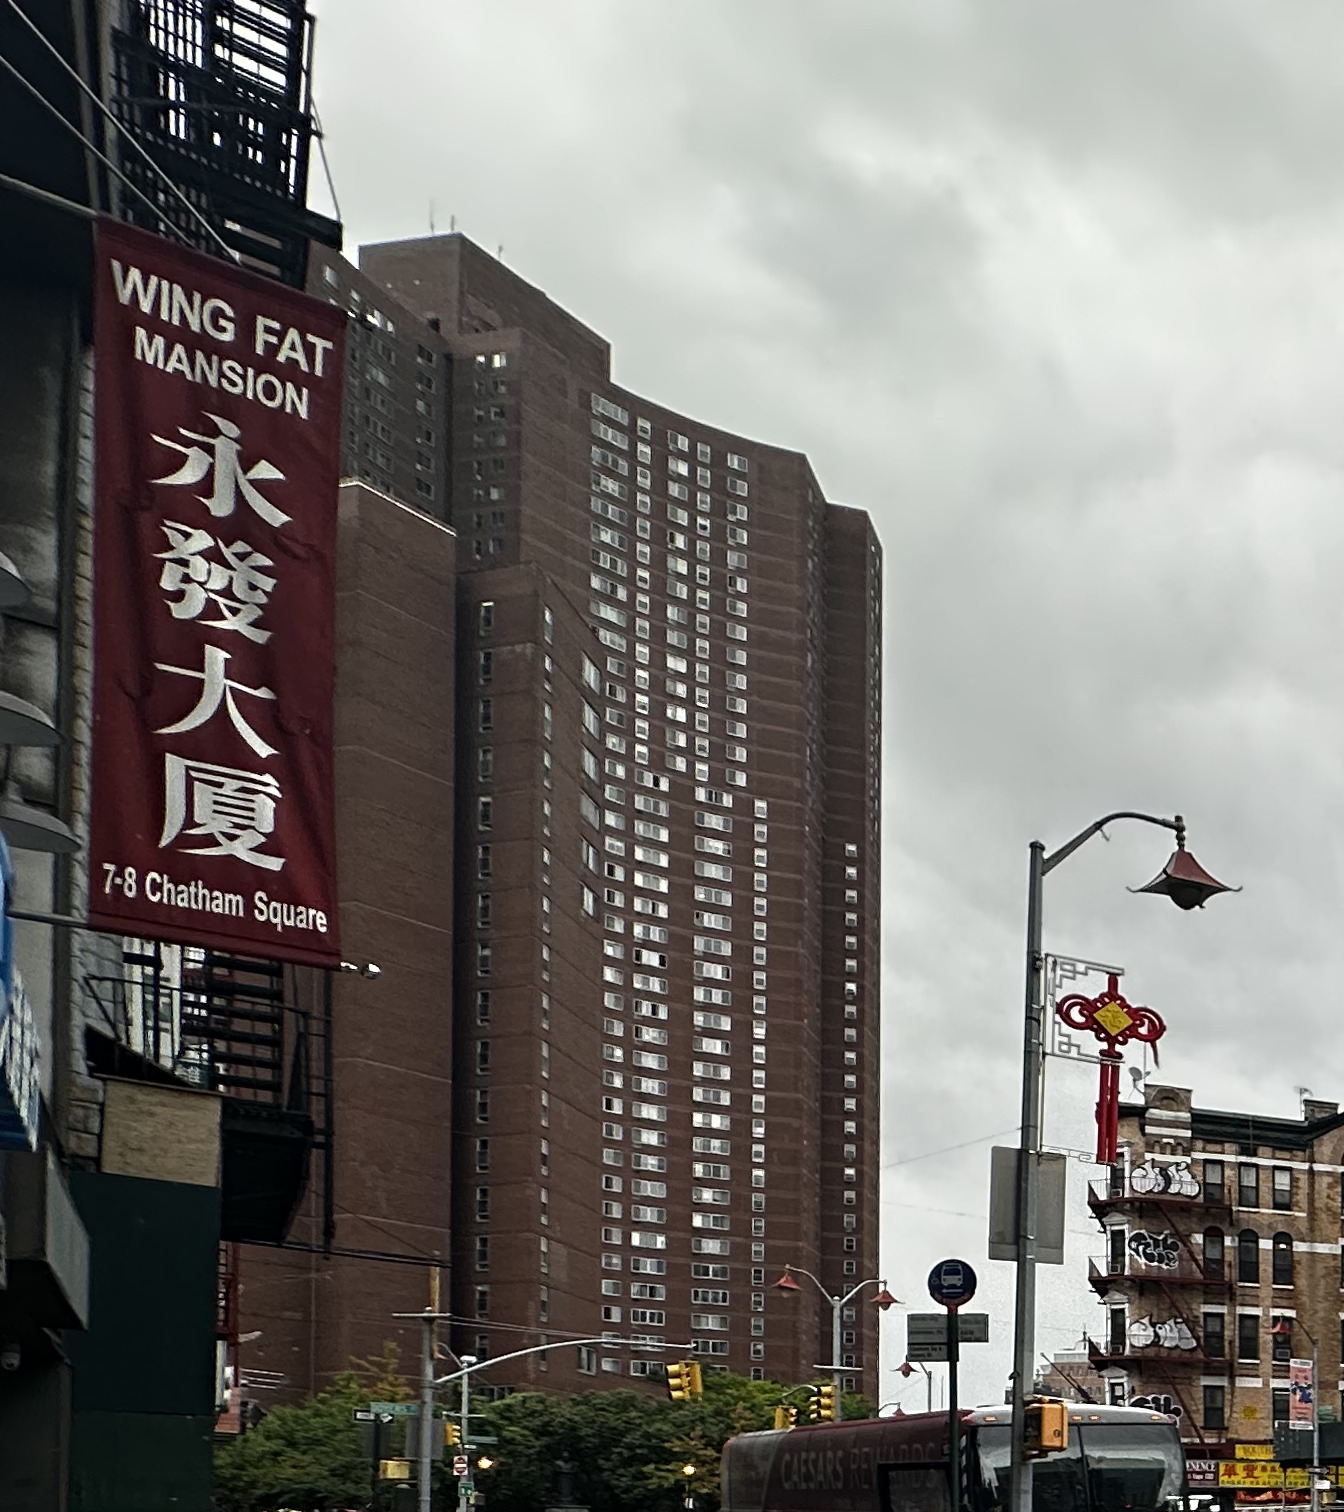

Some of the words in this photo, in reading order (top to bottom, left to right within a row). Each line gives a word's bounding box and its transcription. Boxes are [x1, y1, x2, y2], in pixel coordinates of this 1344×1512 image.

[110, 257, 236, 343] WING
[255, 314, 334, 378] FAT
[133, 325, 309, 420] MANSION
[102, 862, 137, 898] 7-8
[145, 871, 244, 918] Chatham
[254, 890, 328, 934] Square
[781, 1449, 844, 1491] CAESARS
